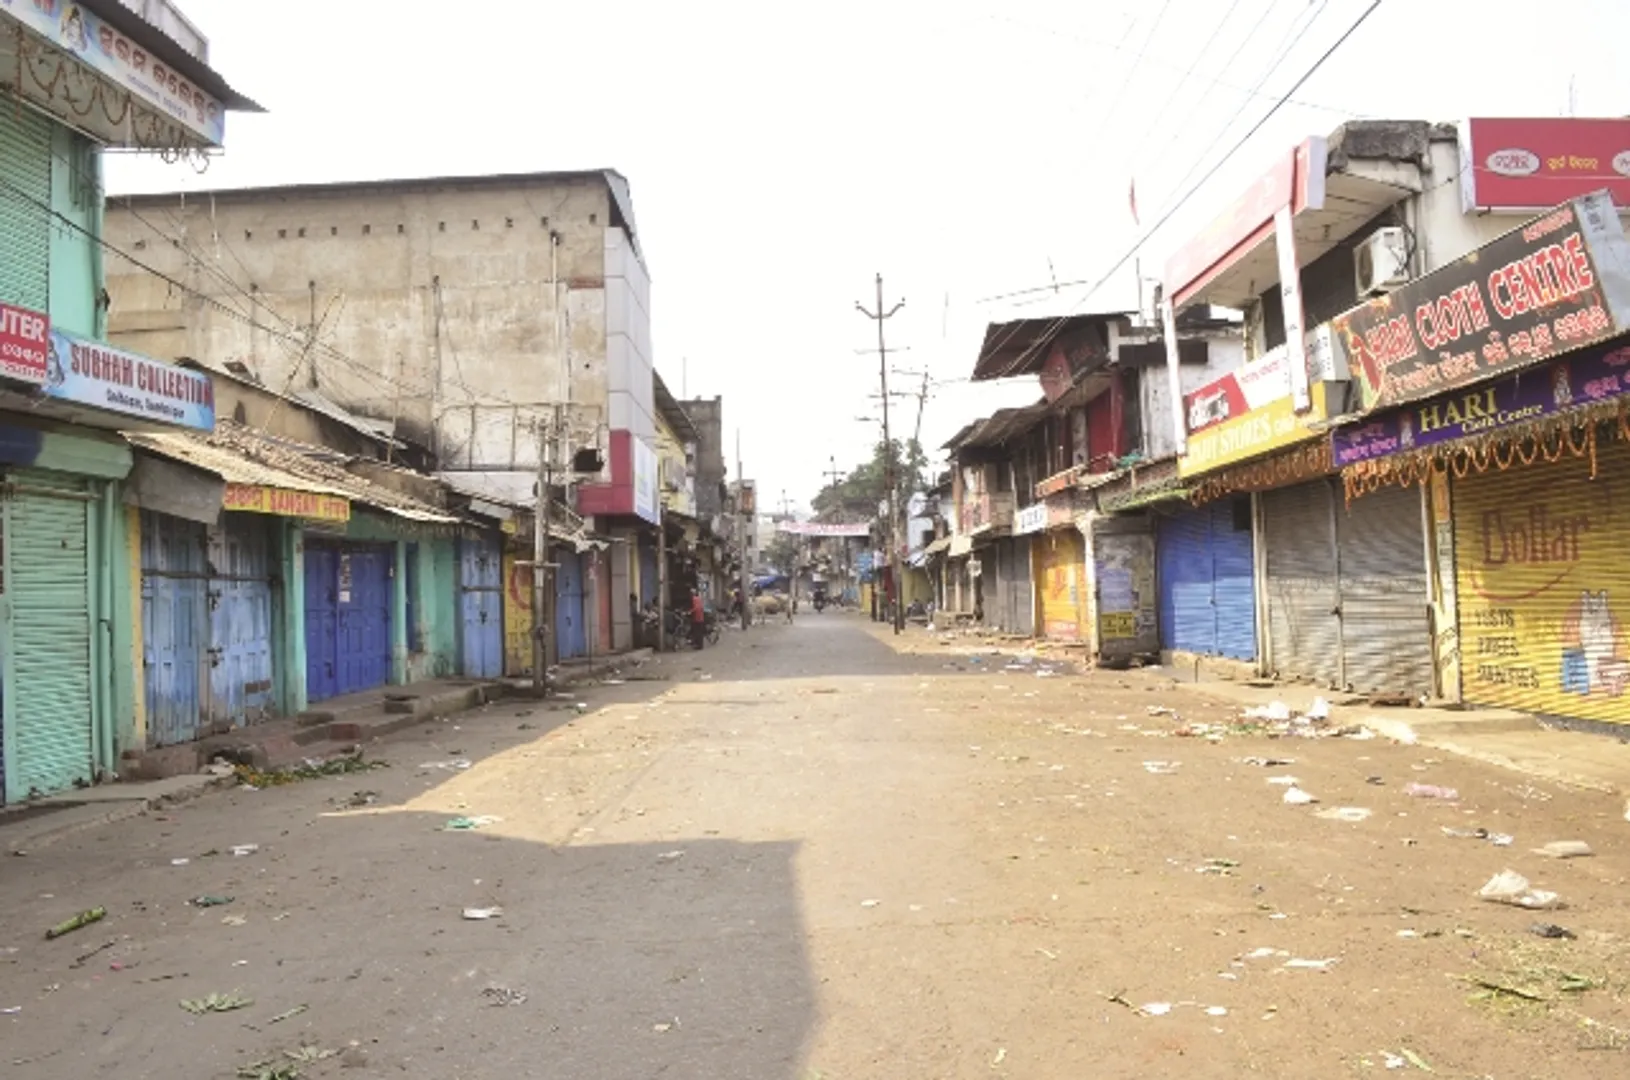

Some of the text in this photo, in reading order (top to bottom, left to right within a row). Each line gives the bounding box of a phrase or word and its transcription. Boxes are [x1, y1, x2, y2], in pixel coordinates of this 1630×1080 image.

[1488, 232, 1594, 319] CENTRE
[71, 343, 134, 388] SUBHAM
[137, 360, 214, 408] COLLECTION
[1419, 387, 1498, 432] HARI
[1498, 402, 1543, 425] Centre
[1482, 506, 1591, 564] Dollar
